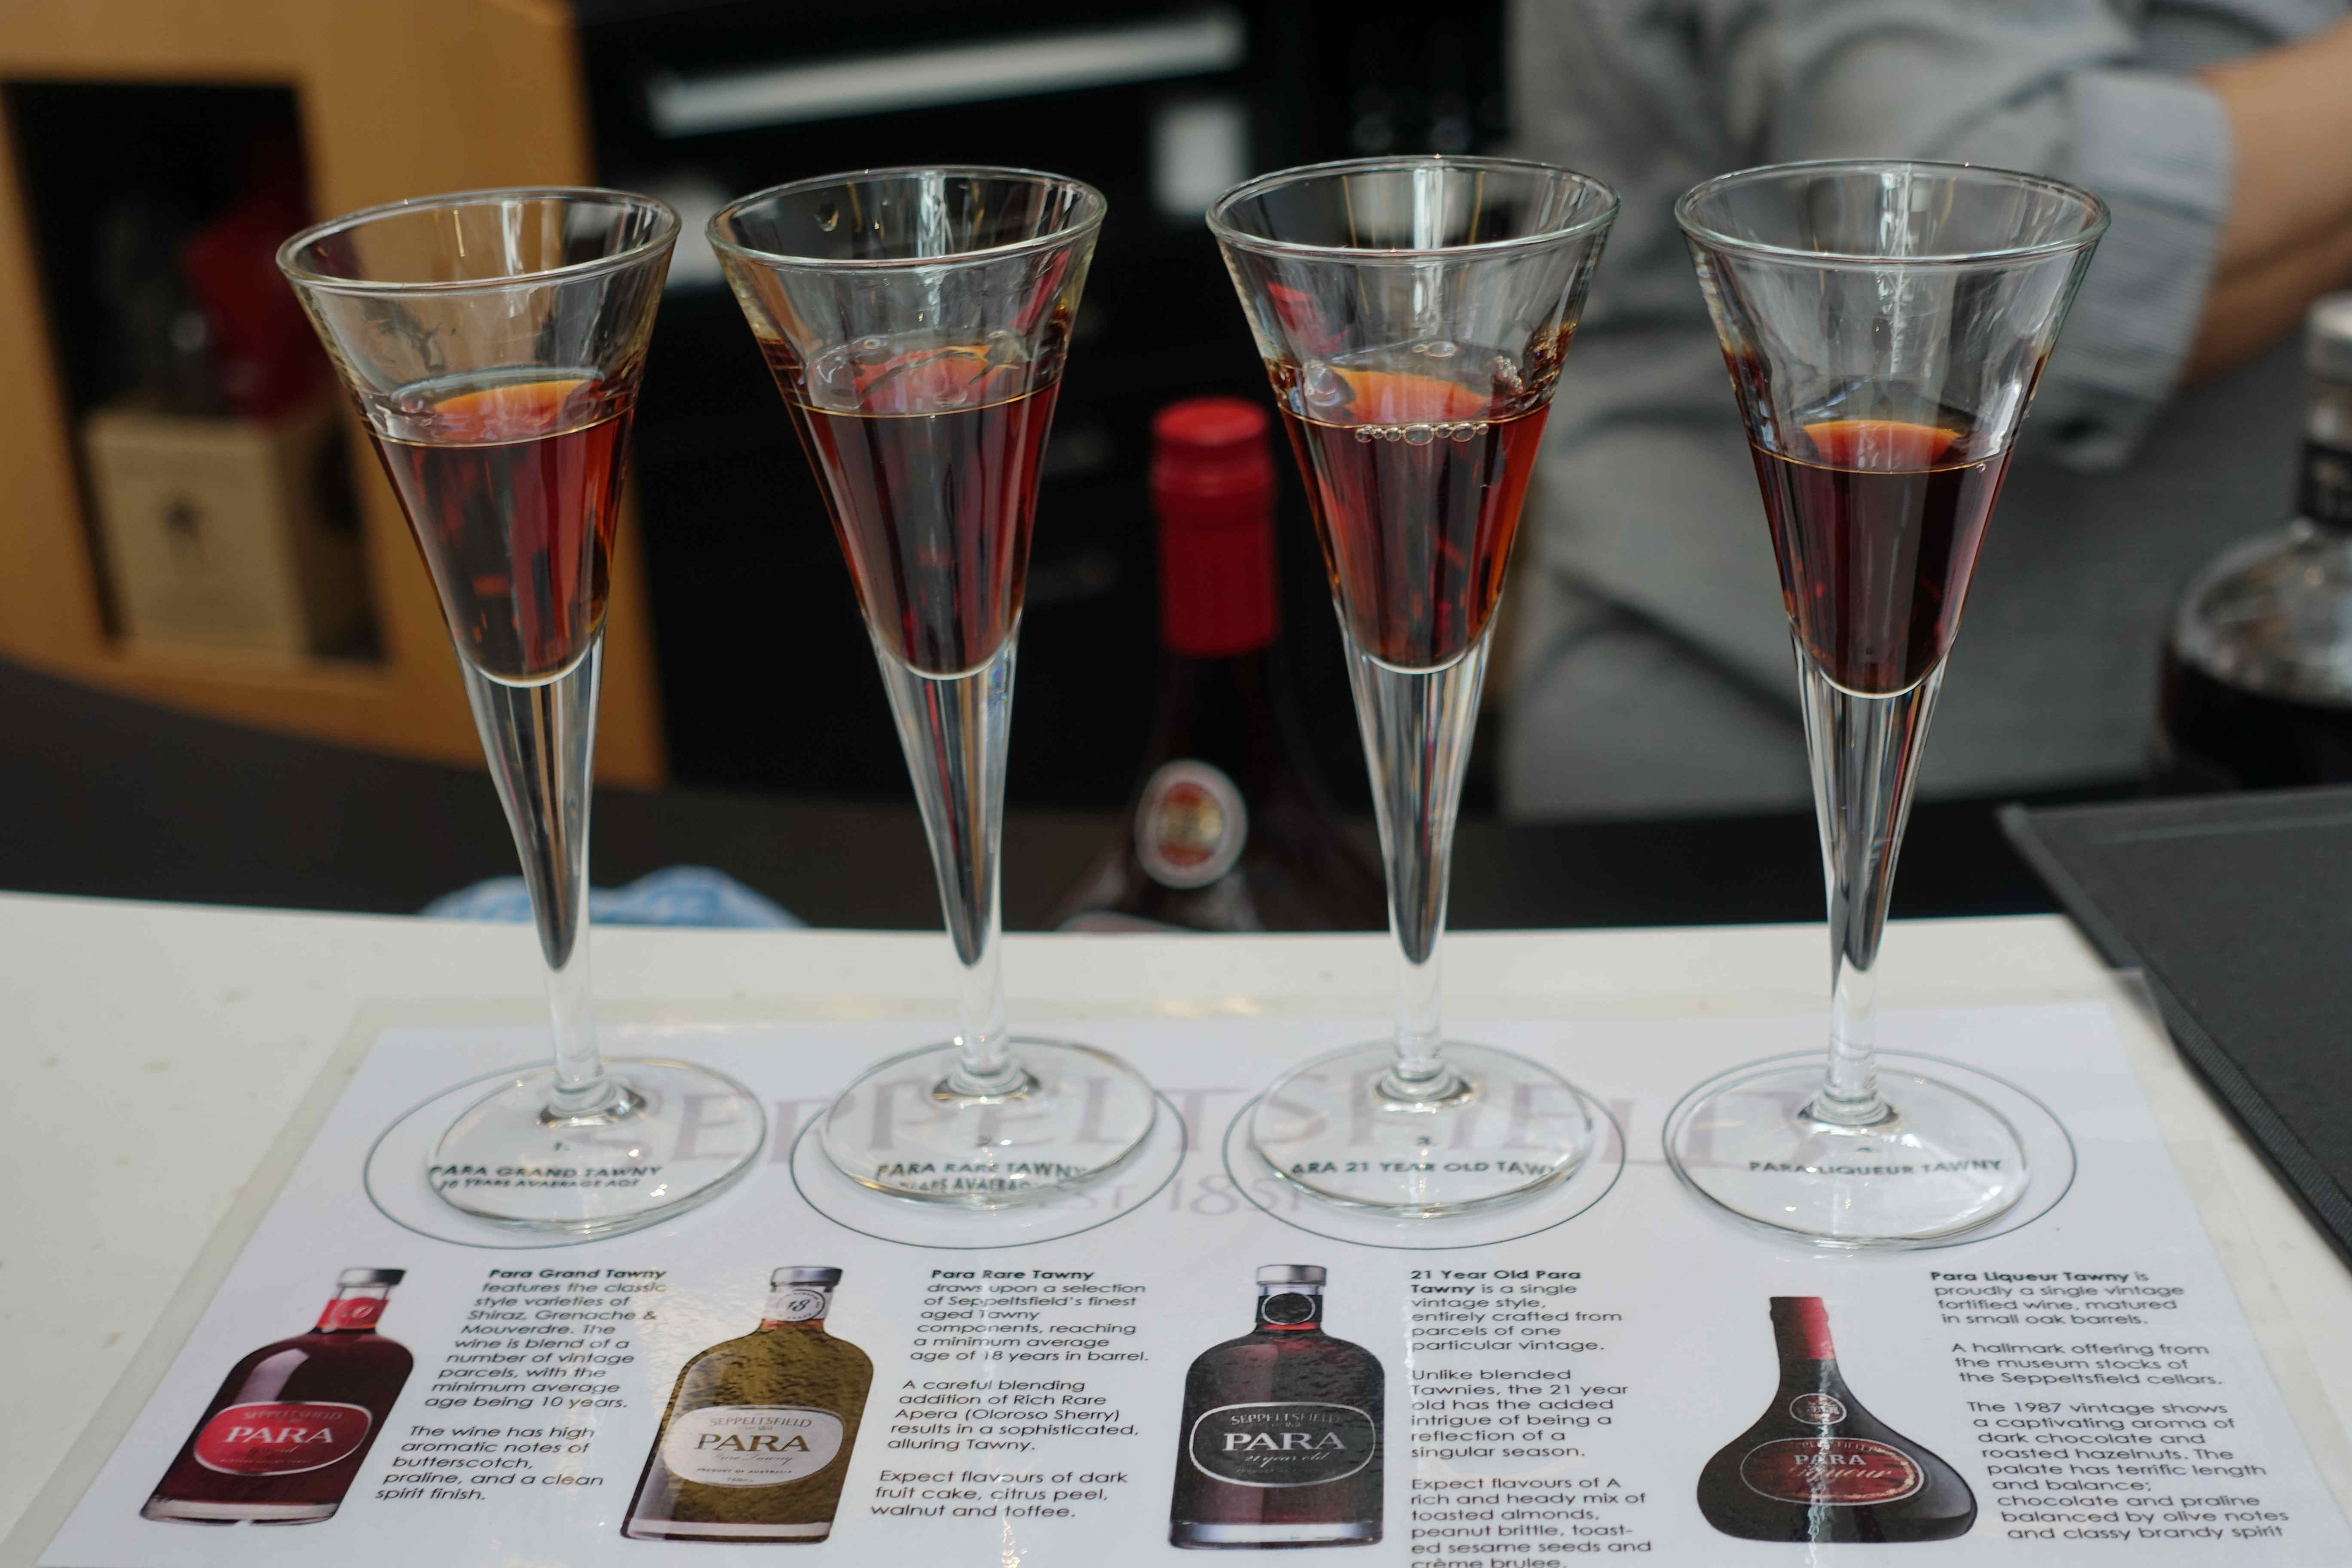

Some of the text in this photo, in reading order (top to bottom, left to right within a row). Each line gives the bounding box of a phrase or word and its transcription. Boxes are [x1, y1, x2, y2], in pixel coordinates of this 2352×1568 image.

[496, 1164, 577, 1178] GRAND
[585, 1164, 662, 1178] TAWNY
[874, 1161, 936, 1179] PARA
[1290, 1161, 1338, 1177] ARA
[1344, 1161, 1369, 1174] 21
[1378, 1161, 1436, 1174] YEAR
[1442, 1161, 1488, 1174] OLD
[1748, 1158, 2002, 1176] PARA LIQUEUR TAWNY
[488, 1268, 667, 1280] Para Grand Tawny
[931, 1269, 1095, 1281] Para Rare Tawny
[1410, 1270, 1581, 1279] 21 Year Old Para
[1929, 1271, 2149, 1283] Para Liqueur Tawny is
[455, 1338, 502, 1348] wine
[506, 1339, 519, 1348] is
[525, 1338, 585, 1348] blend
[589, 1338, 611, 1348] of
[438, 1367, 606, 1379] parcels, with the
[1412, 1369, 1571, 1380] Unlike blended
[902, 1380, 1085, 1393] A careful blending
[1412, 1384, 1629, 1396] Tawnies, the 21 year
[425, 1396, 627, 1409] age being 10 years.
[899, 1394, 1107, 1405] addition of Rich Rare
[894, 1409, 1119, 1422] Apera (Oloroso Sherry)
[1966, 1402, 2228, 1416] The 1987 vintage shows
[709, 1416, 813, 1428] SEPPELTSFIELD
[1973, 1418, 2235, 1431] a captivating aroma of
[223, 1426, 334, 1444] PARA
[410, 1426, 594, 1440] The wine has high
[891, 1424, 951, 1434] results
[957, 1424, 973, 1434] in
[999, 1424, 1138, 1437] sophisticated,
[693, 1432, 812, 1452] PARA
[1221, 1431, 1348, 1452] PARA
[1978, 1432, 2206, 1444] dark chocolate and
[401, 1442, 591, 1453] aromatic notes of
[887, 1438, 1035, 1452] alluring Tawny.
[1412, 1446, 1585, 1460] singular season.
[392, 1456, 533, 1470] butterscotch,
[1793, 1454, 1867, 1466] PARA
[1987, 1464, 2267, 1478] palate has terrific length
[382, 1472, 603, 1485] praline, and a clean
[1412, 1477, 1621, 1491] Expect flavours of A
[375, 1488, 485, 1501] spirit finish.
[876, 1486, 1107, 1503] fruit cake, citrus peel,
[1411, 1492, 1646, 1506] rich and heady mix of
[870, 1504, 1075, 1517] walnut and toffee.
[1412, 1509, 1599, 1521] toasted almonds,
[2001, 1510, 2289, 1525] balanced by olive notes
[1411, 1525, 1632, 1540] peanut brittle, toast-
[2007, 1525, 2282, 1541] and classy brandy spirit
